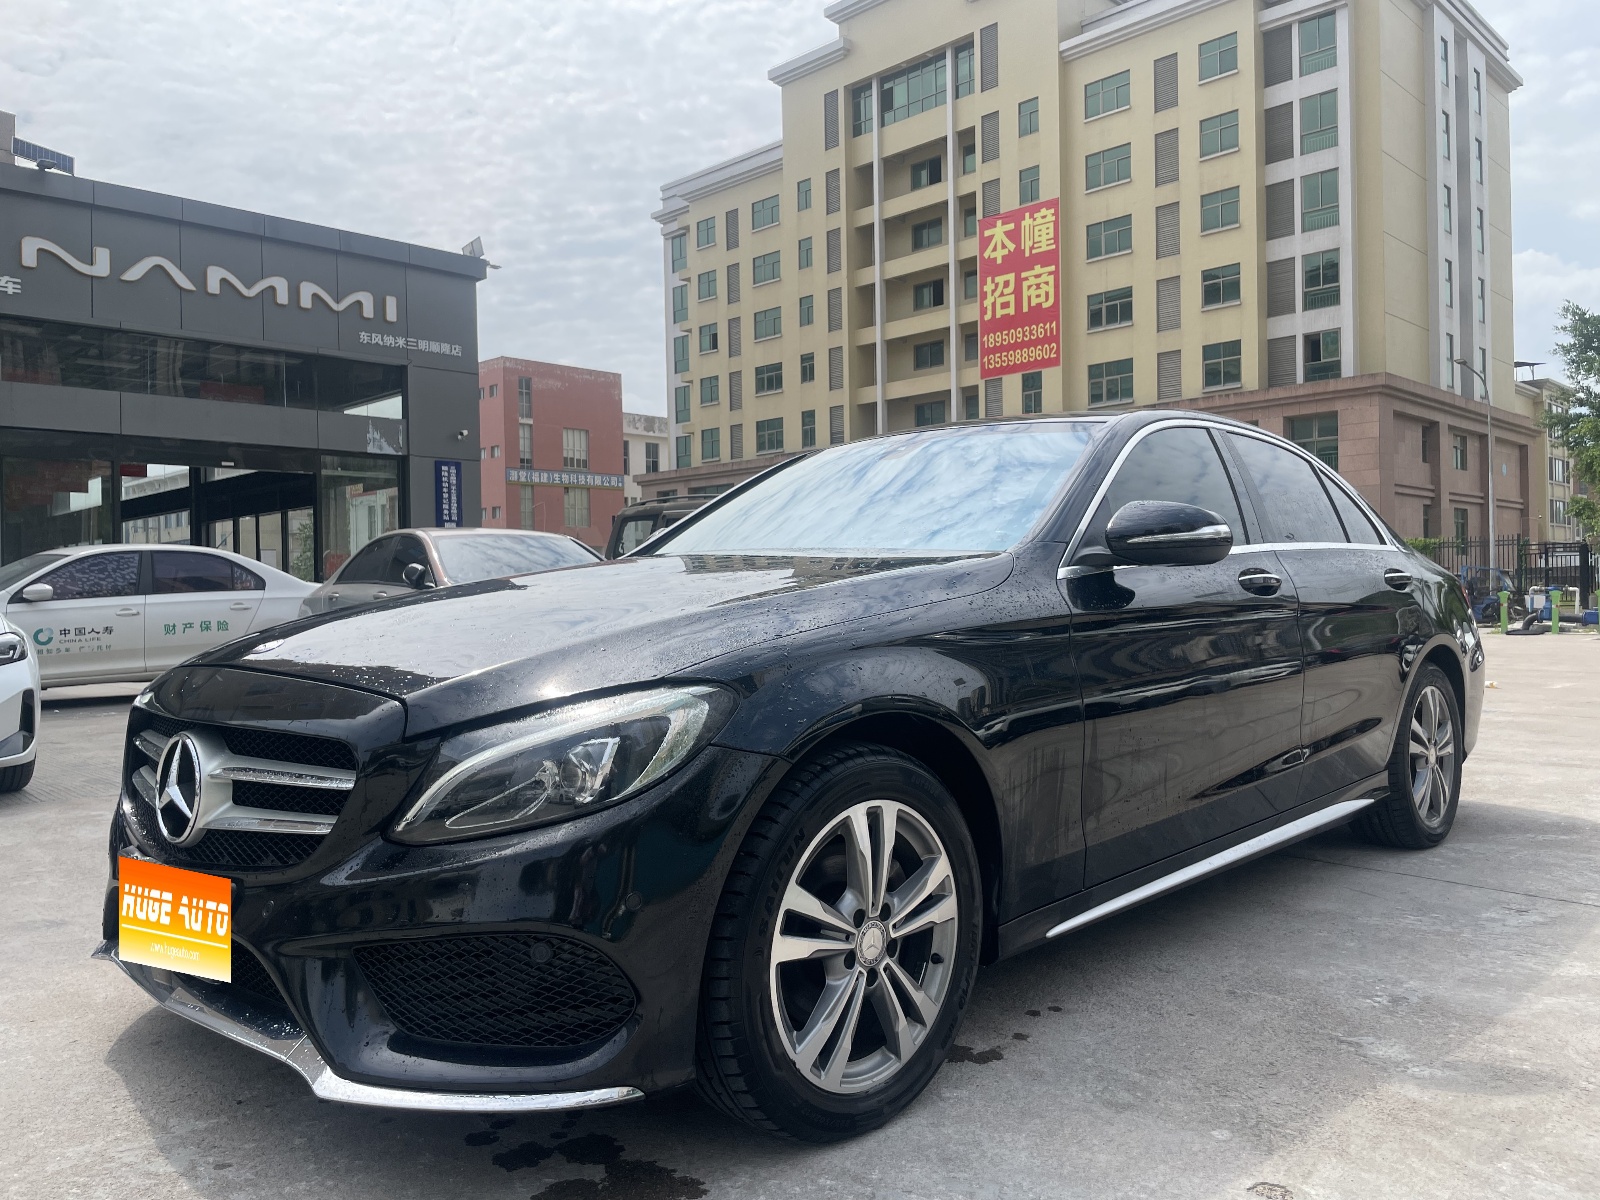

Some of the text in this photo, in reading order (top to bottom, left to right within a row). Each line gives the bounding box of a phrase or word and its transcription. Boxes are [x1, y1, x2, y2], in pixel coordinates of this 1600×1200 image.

[983, 207, 1056, 265] 本幢
[20, 235, 398, 323] NAMMI
[983, 264, 1056, 321] 招商
[358, 331, 463, 358] 东风纳米三明顺隆店
[982, 320, 1057, 349] 18950933611
[982, 342, 1057, 370] 13559889602
[59, 625, 114, 638] 中国人寿
[59, 637, 83, 645] CHINA
[163, 620, 230, 636] 财产保险
